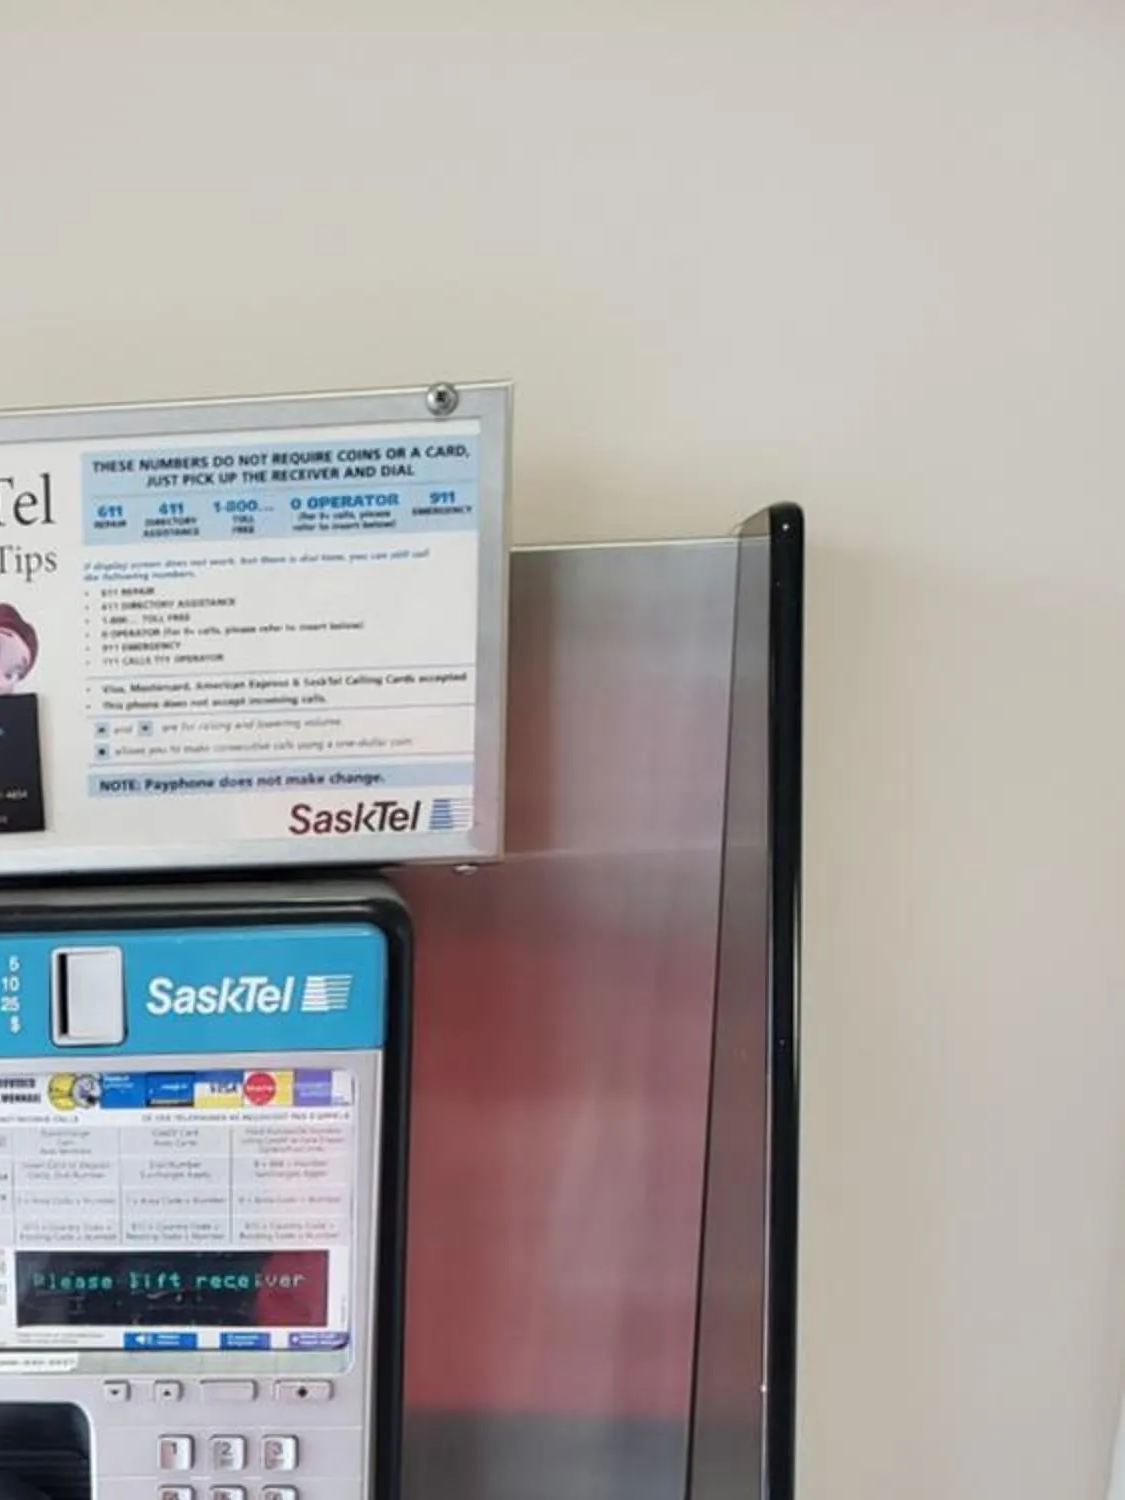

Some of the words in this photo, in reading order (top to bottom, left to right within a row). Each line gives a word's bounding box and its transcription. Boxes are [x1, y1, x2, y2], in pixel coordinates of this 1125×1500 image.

[93, 459, 134, 473] THESE
[139, 456, 208, 472] NUMBERS
[213, 455, 234, 467] DO
[239, 454, 267, 466] NOT
[272, 451, 332, 465] REQUIRE
[337, 449, 381, 462] COINS
[386, 447, 407, 459] OR
[411, 447, 421, 458] A
[147, 475, 177, 488] JUST
[182, 473, 215, 486] PICK
[219, 472, 237, 484] UP
[242, 470, 267, 482] THE
[272, 468, 339, 482] RECEIVER
[344, 466, 375, 479] AND
[381, 464, 415, 477] DIAL
[307, 492, 399, 509] OPERATOR
[429, 491, 456, 504] 911
[97, 505, 124, 518] 611
[158, 502, 185, 515] 411
[412, 505, 472, 516] EMERGENCY
[196, 680, 245, 690] American
[249, 678, 289, 690] Express
[304, 676, 342, 687] SaskTel
[345, 674, 383, 687] Calling
[386, 673, 416, 684] Cards
[419, 671, 467, 684] accepted
[126, 699, 159, 711] phone
[162, 698, 187, 708] does
[191, 698, 208, 707] not
[212, 696, 245, 708] accept
[99, 777, 141, 792] NOTE:
[145, 776, 215, 793] Payphone
[219, 775, 253, 788] does
[257, 774, 282, 787] not
[286, 772, 324, 785] make
[329, 771, 384, 787] change.
[289, 800, 422, 836] SaskTel
[8, 956, 19, 971] 5
[1, 976, 19, 991] 10
[146, 976, 295, 1015] SaskTel
[0, 997, 20, 1012] 25
[33, 1271, 114, 1290] Please
[129, 1271, 181, 1290] lift
[195, 1272, 305, 1289] receiver
